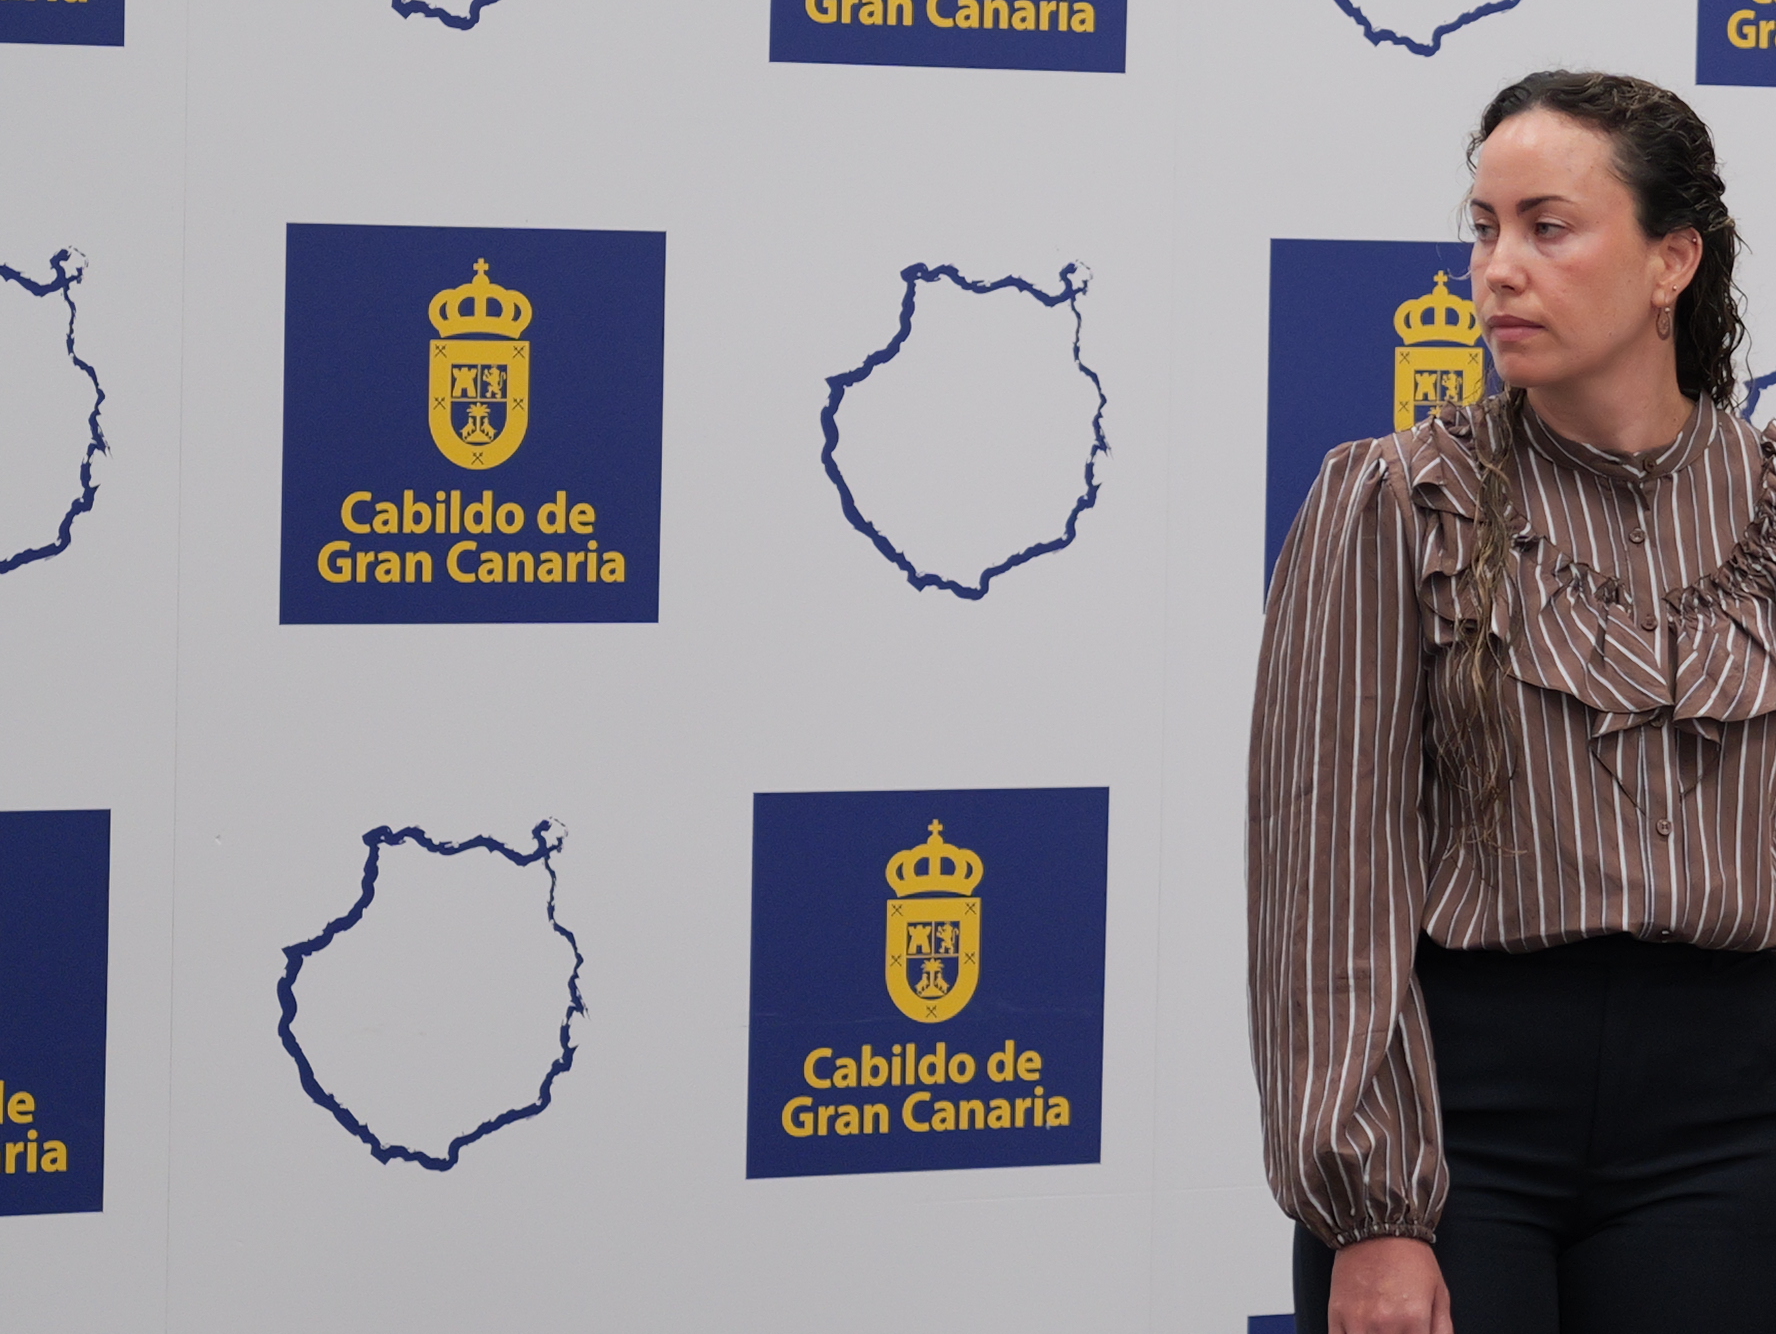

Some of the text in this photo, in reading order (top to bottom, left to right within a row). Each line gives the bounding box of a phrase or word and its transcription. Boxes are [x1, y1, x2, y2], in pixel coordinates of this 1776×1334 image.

[342, 489, 596, 534] Cabildo de
[318, 539, 625, 583] Gran Canaria
[805, 1040, 1042, 1088] Cabildo de
[783, 1086, 1070, 1137] Gran Canaria
